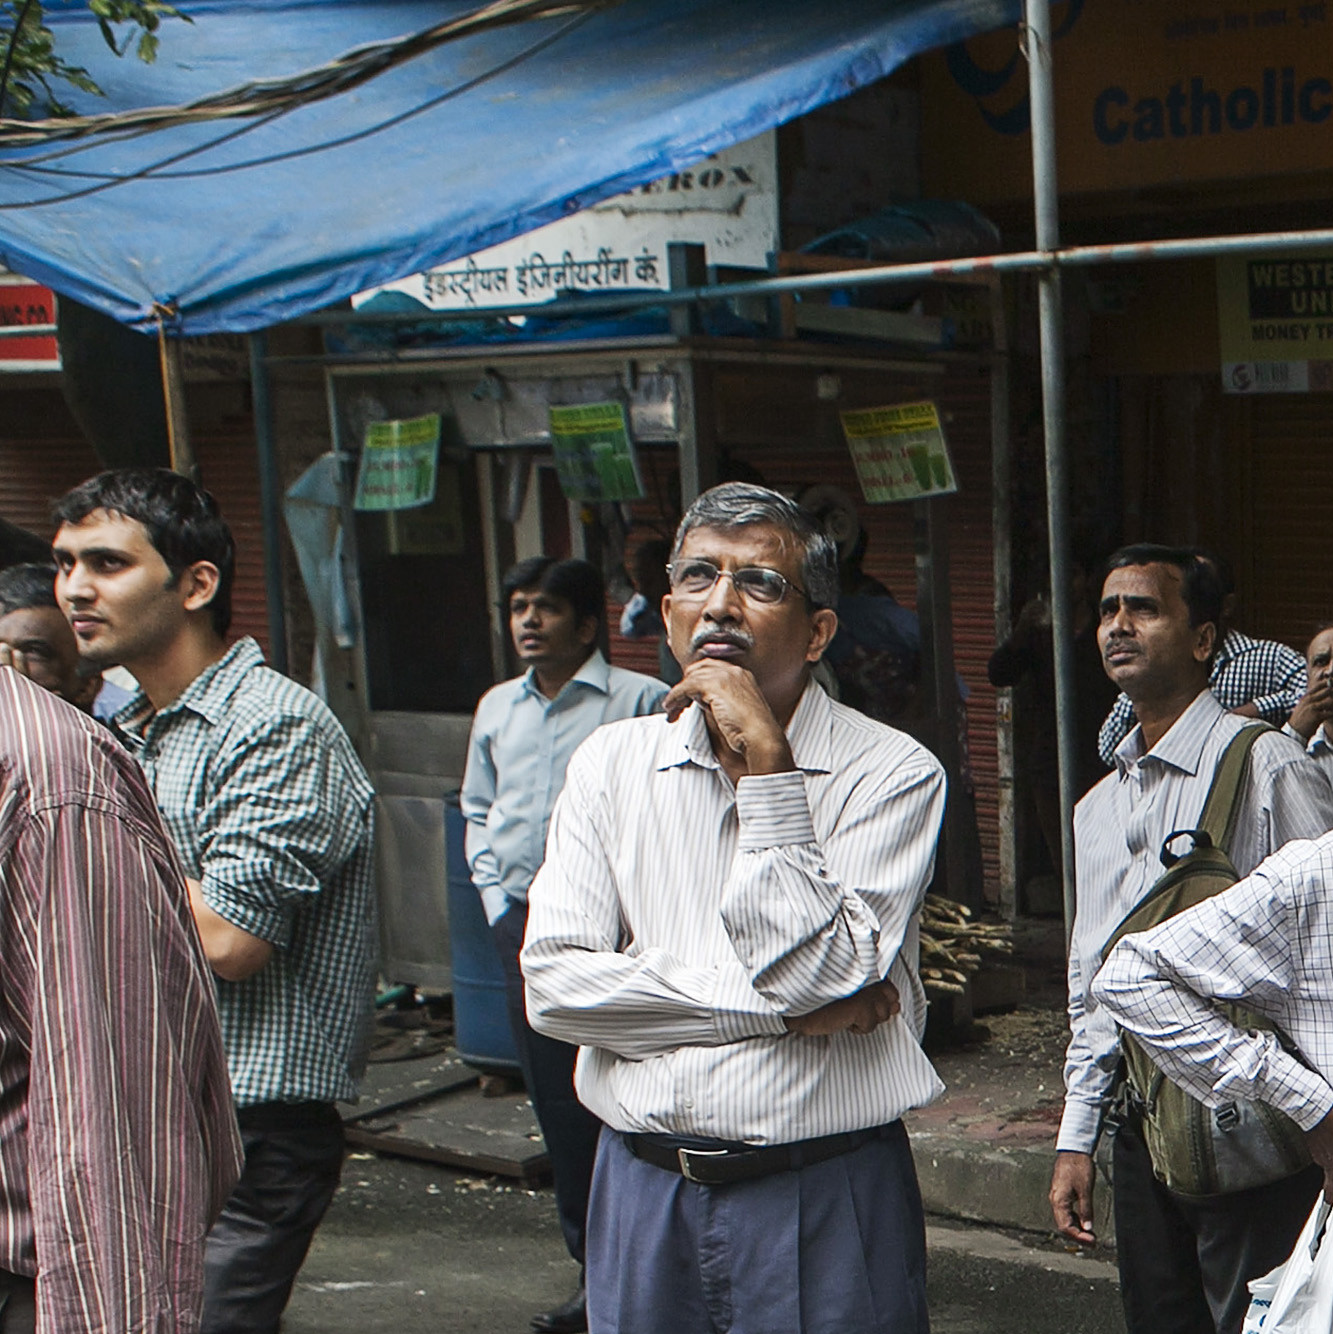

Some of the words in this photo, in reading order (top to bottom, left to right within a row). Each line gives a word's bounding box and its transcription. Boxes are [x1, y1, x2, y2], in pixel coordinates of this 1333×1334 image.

[1093, 67, 1333, 145] Catholic
[624, 165, 757, 195] EROX
[1251, 324, 1309, 340] MONEY
